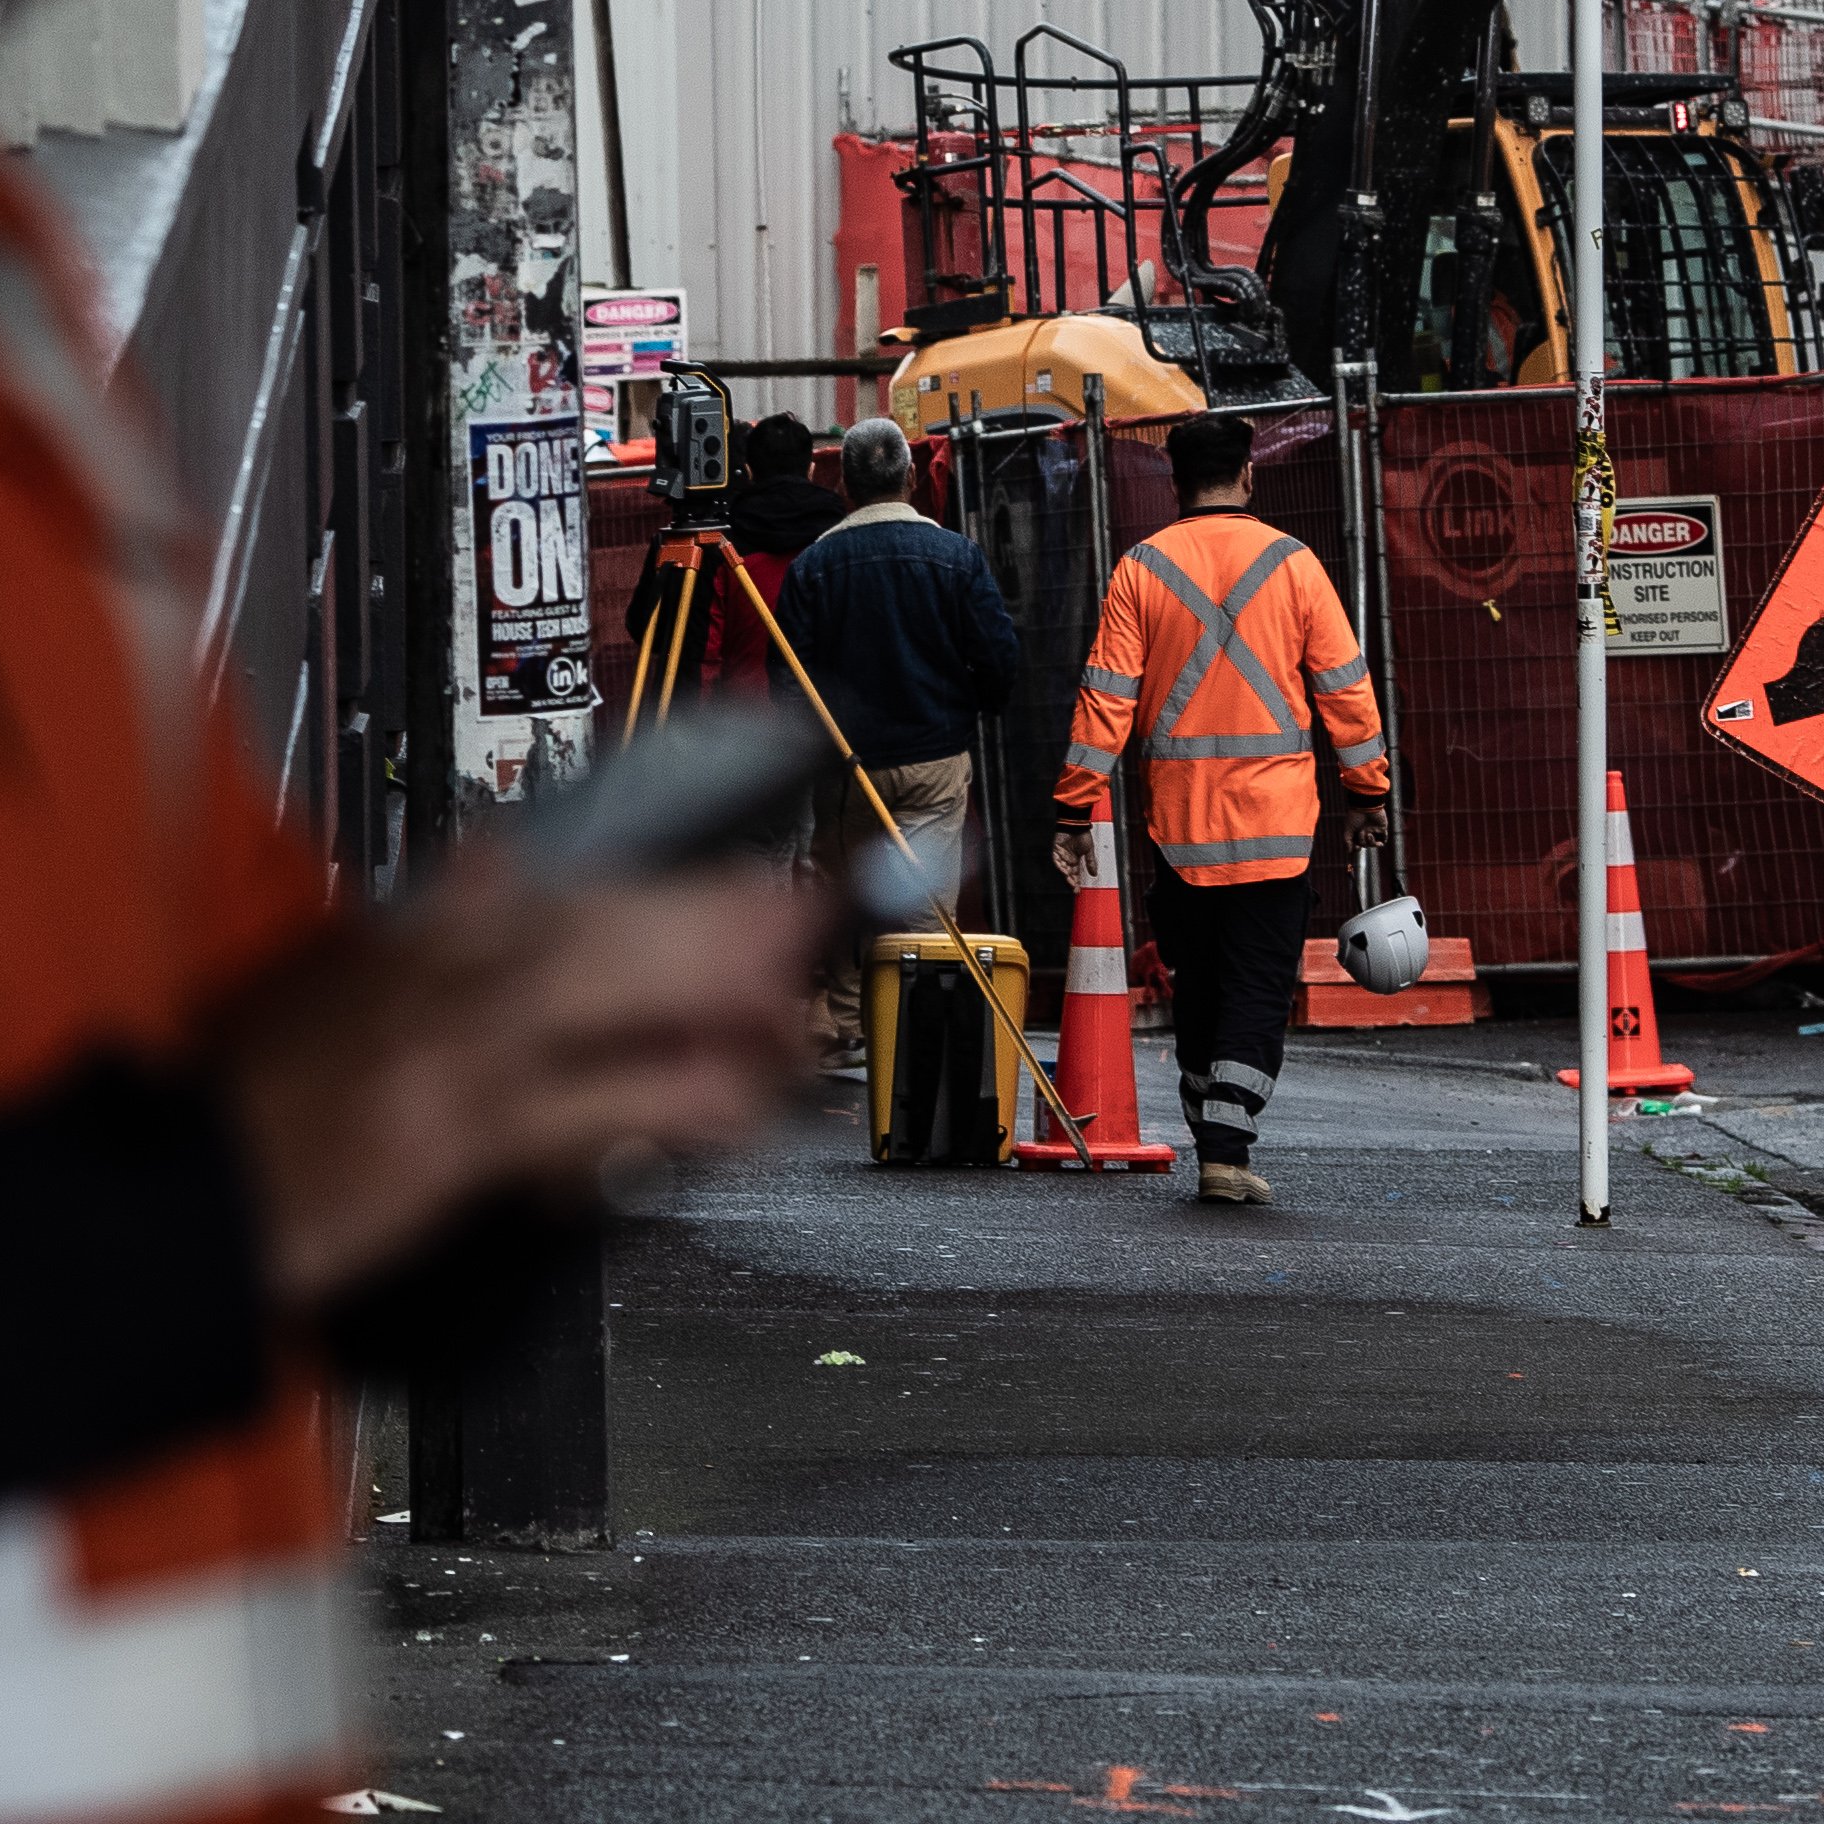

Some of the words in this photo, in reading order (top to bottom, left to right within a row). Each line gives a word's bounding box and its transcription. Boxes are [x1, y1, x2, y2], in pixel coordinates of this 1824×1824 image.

[486, 438, 580, 500] DONE
[1442, 504, 1515, 538] Link
[491, 496, 584, 607] ON
[1634, 585, 1670, 603] SITE
[491, 608, 544, 620] FEATURING
[1670, 610, 1719, 623] PERSONS
[491, 621, 533, 641] HOUSE
[1630, 630, 1657, 643] KEEP
[1659, 629, 1681, 642] OUT
